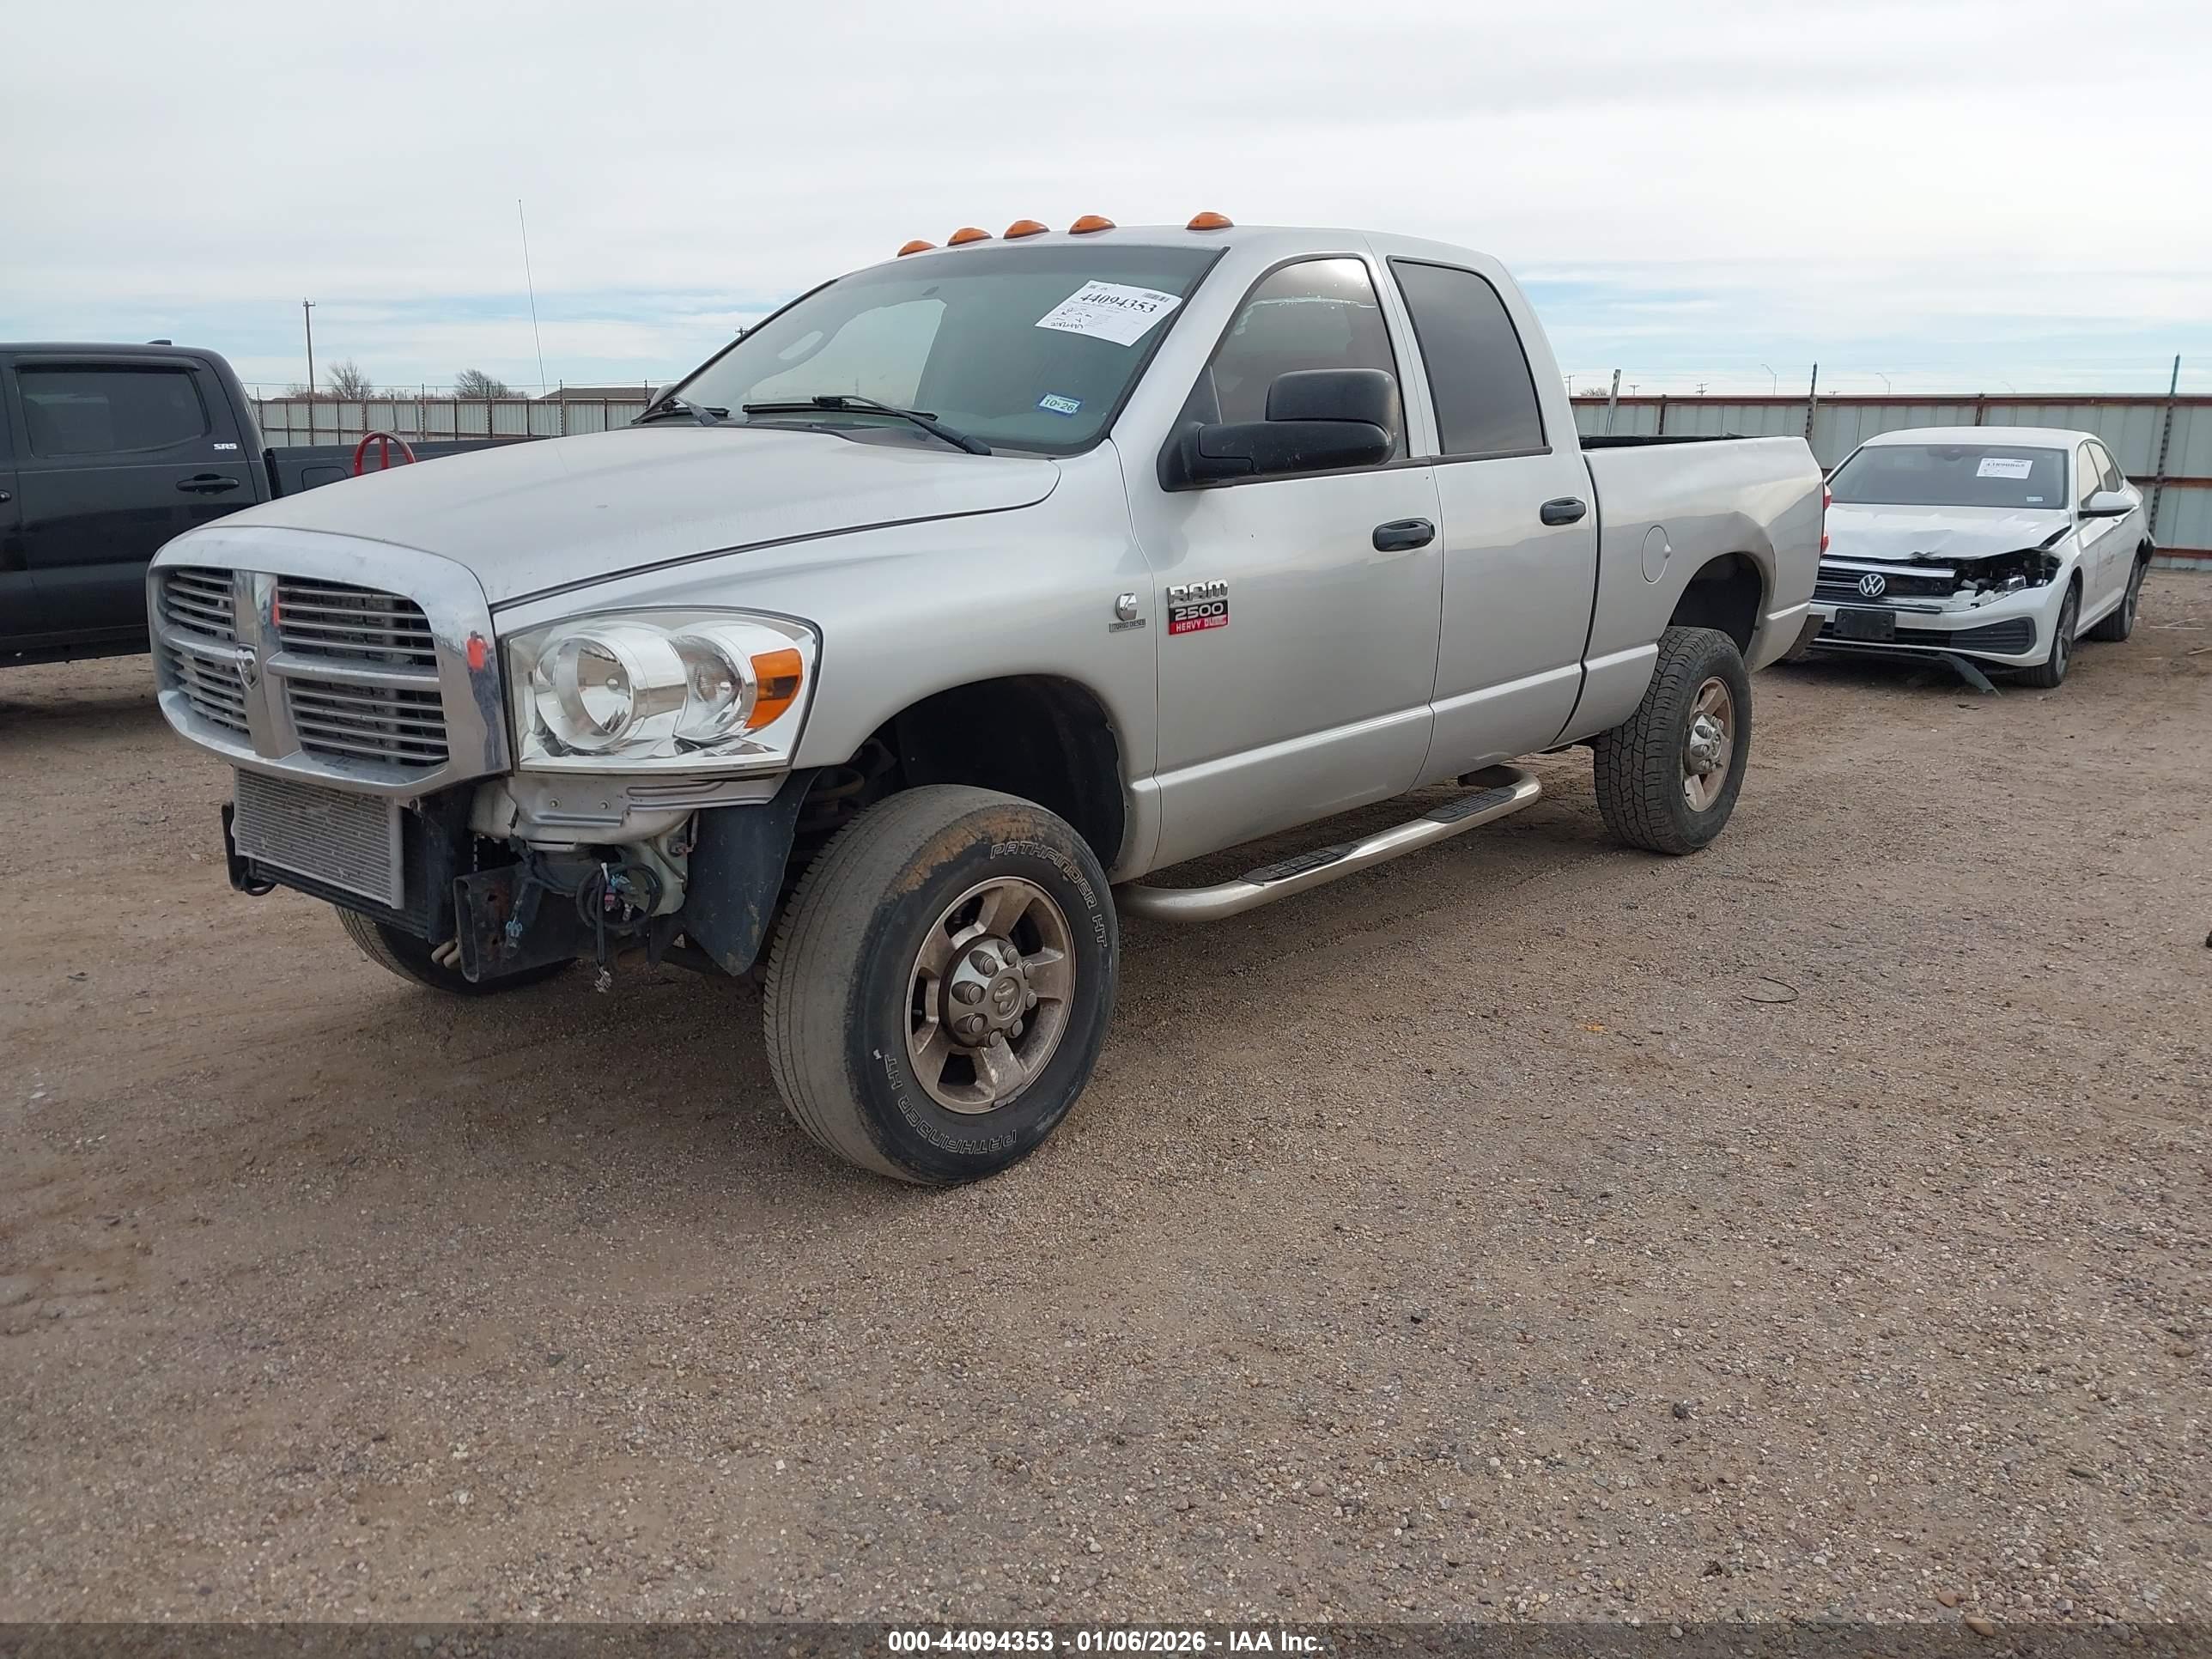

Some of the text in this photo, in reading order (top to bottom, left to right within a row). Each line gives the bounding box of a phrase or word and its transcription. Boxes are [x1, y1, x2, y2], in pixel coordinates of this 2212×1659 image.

[1080, 293, 1158, 313] 44094353
[1167, 579, 1229, 605] RAM
[1175, 602, 1224, 622] 2500
[1176, 618, 1202, 633] HEAVY
[989, 841, 1108, 948] PATHFINDER HT
[884, 1054, 1018, 1155] PATHFINDER HT
